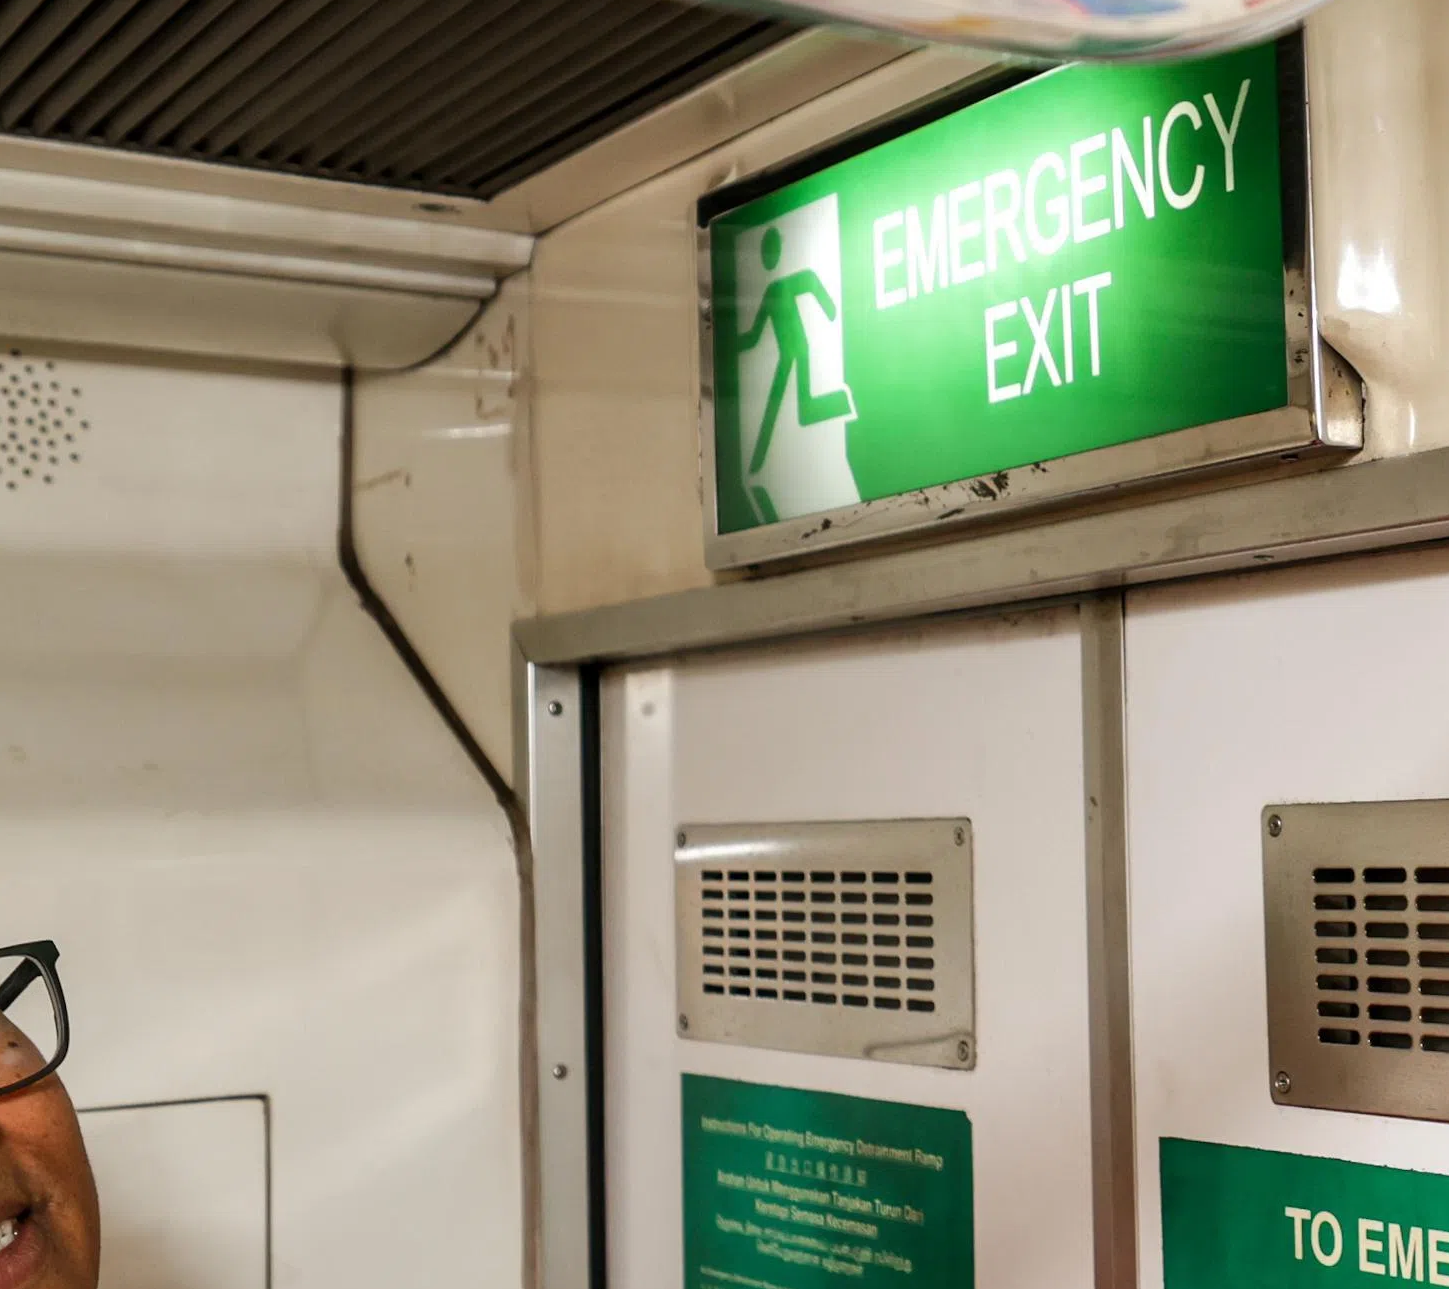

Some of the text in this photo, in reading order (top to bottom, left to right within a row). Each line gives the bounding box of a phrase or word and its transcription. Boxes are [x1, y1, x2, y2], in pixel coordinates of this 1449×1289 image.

[872, 79, 1250, 312] EMERGENCY
[982, 272, 1112, 403] EXIT
[1285, 1207, 1342, 1266] TO
